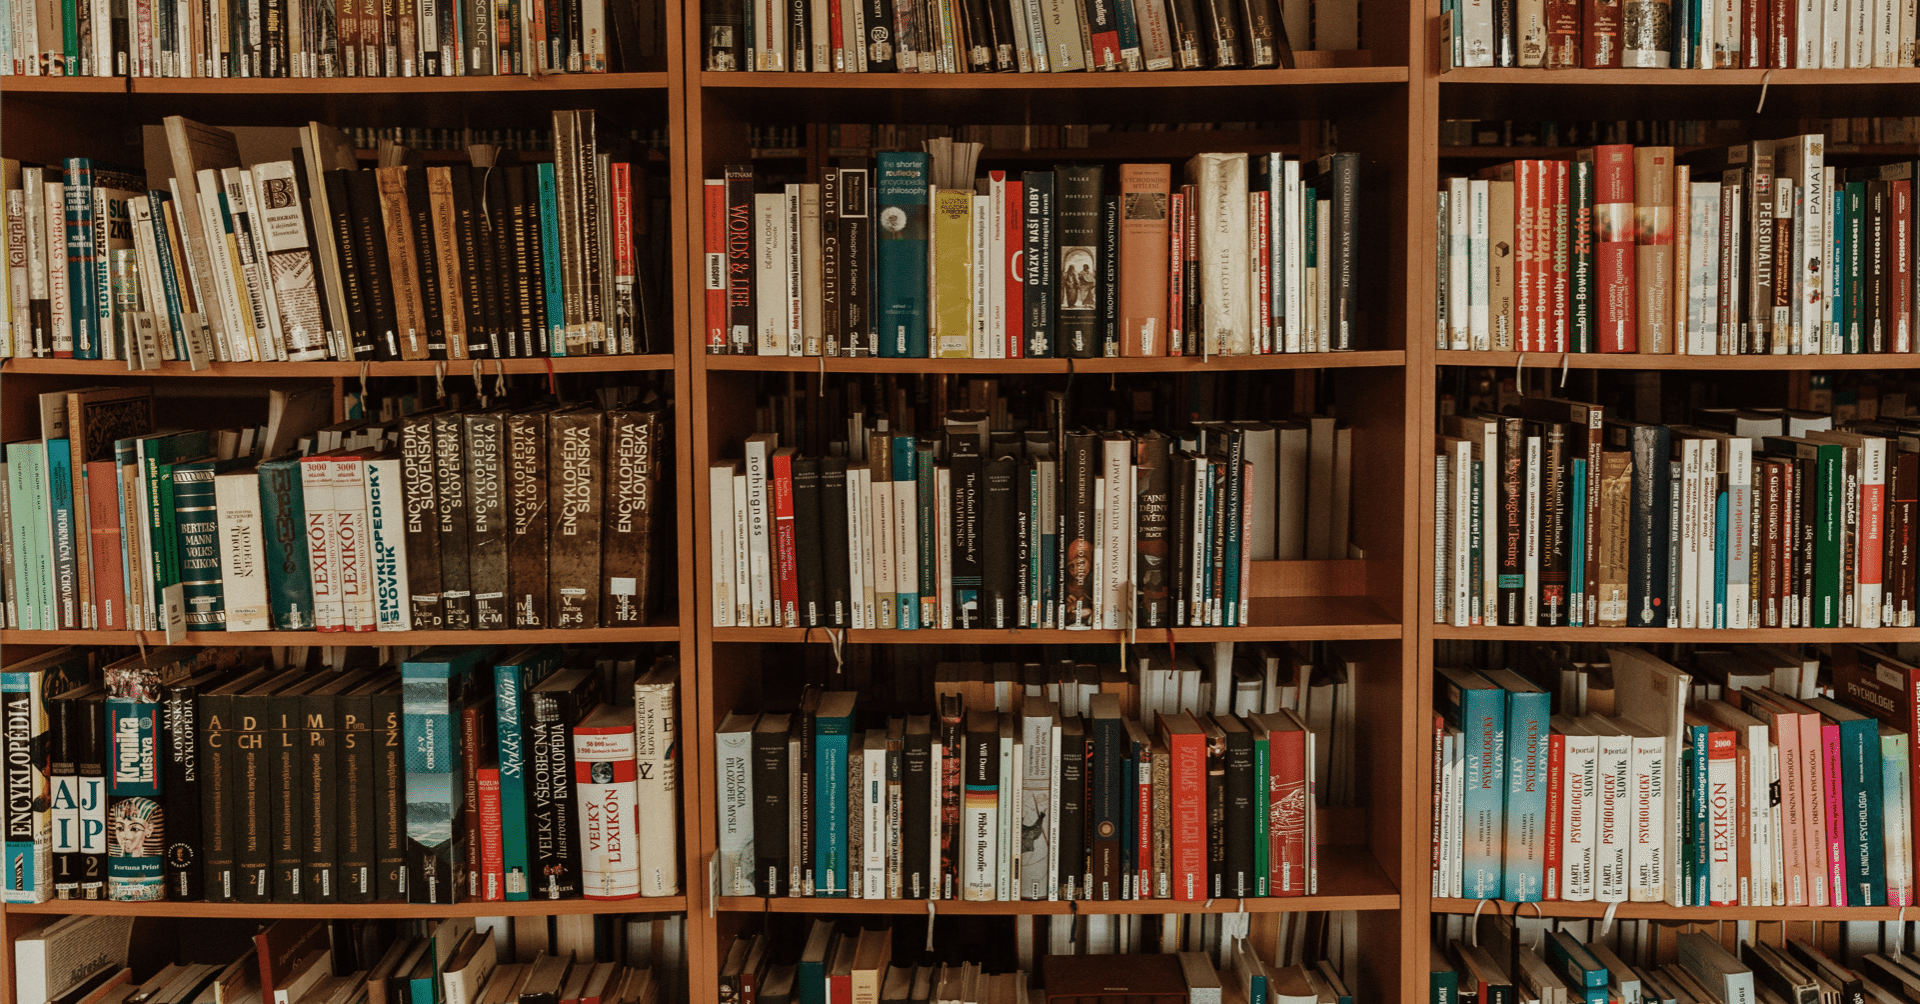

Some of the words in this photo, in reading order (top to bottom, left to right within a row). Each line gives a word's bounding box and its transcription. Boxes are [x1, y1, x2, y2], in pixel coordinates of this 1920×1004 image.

[825, 174, 835, 214] Doubt
[1028, 187, 1039, 214] DOBY
[1107, 201, 1115, 211] JÁ
[1342, 186, 1350, 224] UMBERTO
[617, 221, 626, 256] Science
[730, 203, 749, 259] WORDS
[849, 222, 858, 258] Philosophy
[1027, 219, 1039, 243] NAŠÍ
[1106, 212, 1115, 252] VLASTNÍMU
[1341, 231, 1350, 257] KRÁSY
[1553, 204, 1568, 273] Odloučení
[1574, 208, 1590, 254] Ztráta
[1758, 202, 1772, 287] PERSONALITY
[710, 255, 719, 287] PHILOSOPHY
[730, 263, 749, 273] &
[824, 237, 838, 303] Certainty
[850, 269, 858, 296] Science
[1027, 247, 1039, 285] OTÁZKY
[1107, 259, 1115, 282] CESTY
[1342, 259, 1350, 287] DĚJINY
[1576, 262, 1588, 300] Bowlby
[245, 266, 266, 329] CHRONOLÓGIA
[730, 277, 750, 307] LIFE
[1554, 278, 1566, 316] Bowlby
[1609, 284, 1617, 322] Assessment
[1577, 303, 1587, 326] John
[149, 458, 158, 480] public
[402, 425, 422, 533] ENCYKLOPÉDIA
[418, 424, 434, 509] SLOVENSKA
[437, 424, 452, 532] ENCYKLOPÉDIA
[447, 424, 462, 507] SLOVENSKA
[474, 424, 487, 532] ENCYKLOPÉDIA
[485, 424, 498, 508] SLOVENSKA
[561, 427, 577, 535] ENCYKLOPÉDIA
[577, 427, 591, 513] SLOVENSKA
[618, 424, 634, 533] ENCYKLOPÉDIA
[634, 424, 648, 510] SLOVENSKA
[1544, 449, 1554, 513] EVOLUTIONARY
[151, 480, 159, 506] internet
[750, 456, 762, 536] nothingness
[966, 488, 975, 514] Oxford
[1505, 458, 1521, 527] Psychological
[1554, 480, 1564, 506] Oxford
[1770, 476, 1779, 502] FREUD
[152, 508, 160, 527] access
[327, 513, 336, 548] VZDELANIA
[956, 488, 965, 546] METAPHYSICS
[1112, 494, 1120, 530] KULTURA
[1554, 508, 1563, 545] Handbook
[1769, 503, 1779, 539] SIGMUND
[57, 509, 70, 561] INFORMAČNÁ
[185, 535, 212, 545] MANN
[231, 526, 243, 577] THOUGHT
[243, 525, 253, 577] MODERN
[368, 464, 389, 622] ENCYKLOPEDICKÝ
[966, 515, 975, 554] Handbook
[1076, 511, 1086, 556] OŠKLIVOSTI
[1505, 529, 1516, 566] Testing
[1544, 514, 1553, 568] PSYCHOLOGY
[1804, 542, 1812, 559] nebo
[184, 558, 218, 569] LEXIKON
[309, 513, 329, 596] LEXIKÓN
[330, 550, 339, 594] VŠEOBECNÉHO
[1077, 558, 1085, 585] DĚJINY
[1111, 536, 1120, 574] ASSMANN
[60, 564, 73, 602] VÝCHOVA
[386, 546, 399, 621] SLOVNÍK
[163, 699, 172, 730] MALÁ
[498, 678, 516, 726] lexikón
[172, 699, 183, 762] SLOVENSKÁ
[184, 699, 195, 781] ENCYKLOPÉDIA
[426, 719, 434, 769] SLOVENSKO
[638, 696, 647, 755] ENCYKLOPÉDIA
[647, 708, 656, 755] SLOVENSKA
[1697, 733, 1705, 755] řidiče
[1714, 740, 1732, 748] 2000
[4, 698, 32, 836] ENCYKLOPÉDIA
[116, 717, 140, 782] Kronika
[501, 730, 525, 779] Školský
[530, 723, 550, 807] VŠEOBECNÁ
[549, 724, 567, 799] ENCYKLOPÉDIA
[979, 743, 987, 759] Will
[1480, 716, 1493, 789] PSYCHOLOGICKÝ
[1494, 730, 1504, 779] SLOVNÍK
[1698, 757, 1706, 770] pro
[726, 757, 735, 802] FILOZOFIE
[736, 757, 746, 808] ANTOLÓGIA
[979, 760, 987, 780] Durant
[1467, 754, 1478, 791] VELKÝ
[1584, 758, 1594, 797] SLOVNÍK
[1787, 749, 1796, 792] PSYCHOLÓGIA
[1569, 772, 1582, 843] PSYCHOLOGICKÝ
[1697, 772, 1707, 818] Psychologie
[1789, 794, 1797, 825] FORENZNÁ
[535, 811, 553, 859] VEĽKÁ
[556, 803, 568, 859] ilustrovaná
[585, 801, 601, 851] VEĽKÝ
[605, 789, 621, 863] LEXIKÓN
[727, 804, 736, 833] MYSLE
[1710, 782, 1728, 863] LEXIKÓN
[1859, 791, 1868, 841] PSYCHOLÓGIA
[60, 855, 70, 876] 1
[86, 856, 98, 876] 2
[977, 840, 986, 871] filozofie
[1571, 863, 1579, 886] HARTL
[1582, 847, 1591, 884] HARTLOVÁ
[1860, 842, 1870, 876] KLINICKÁ
